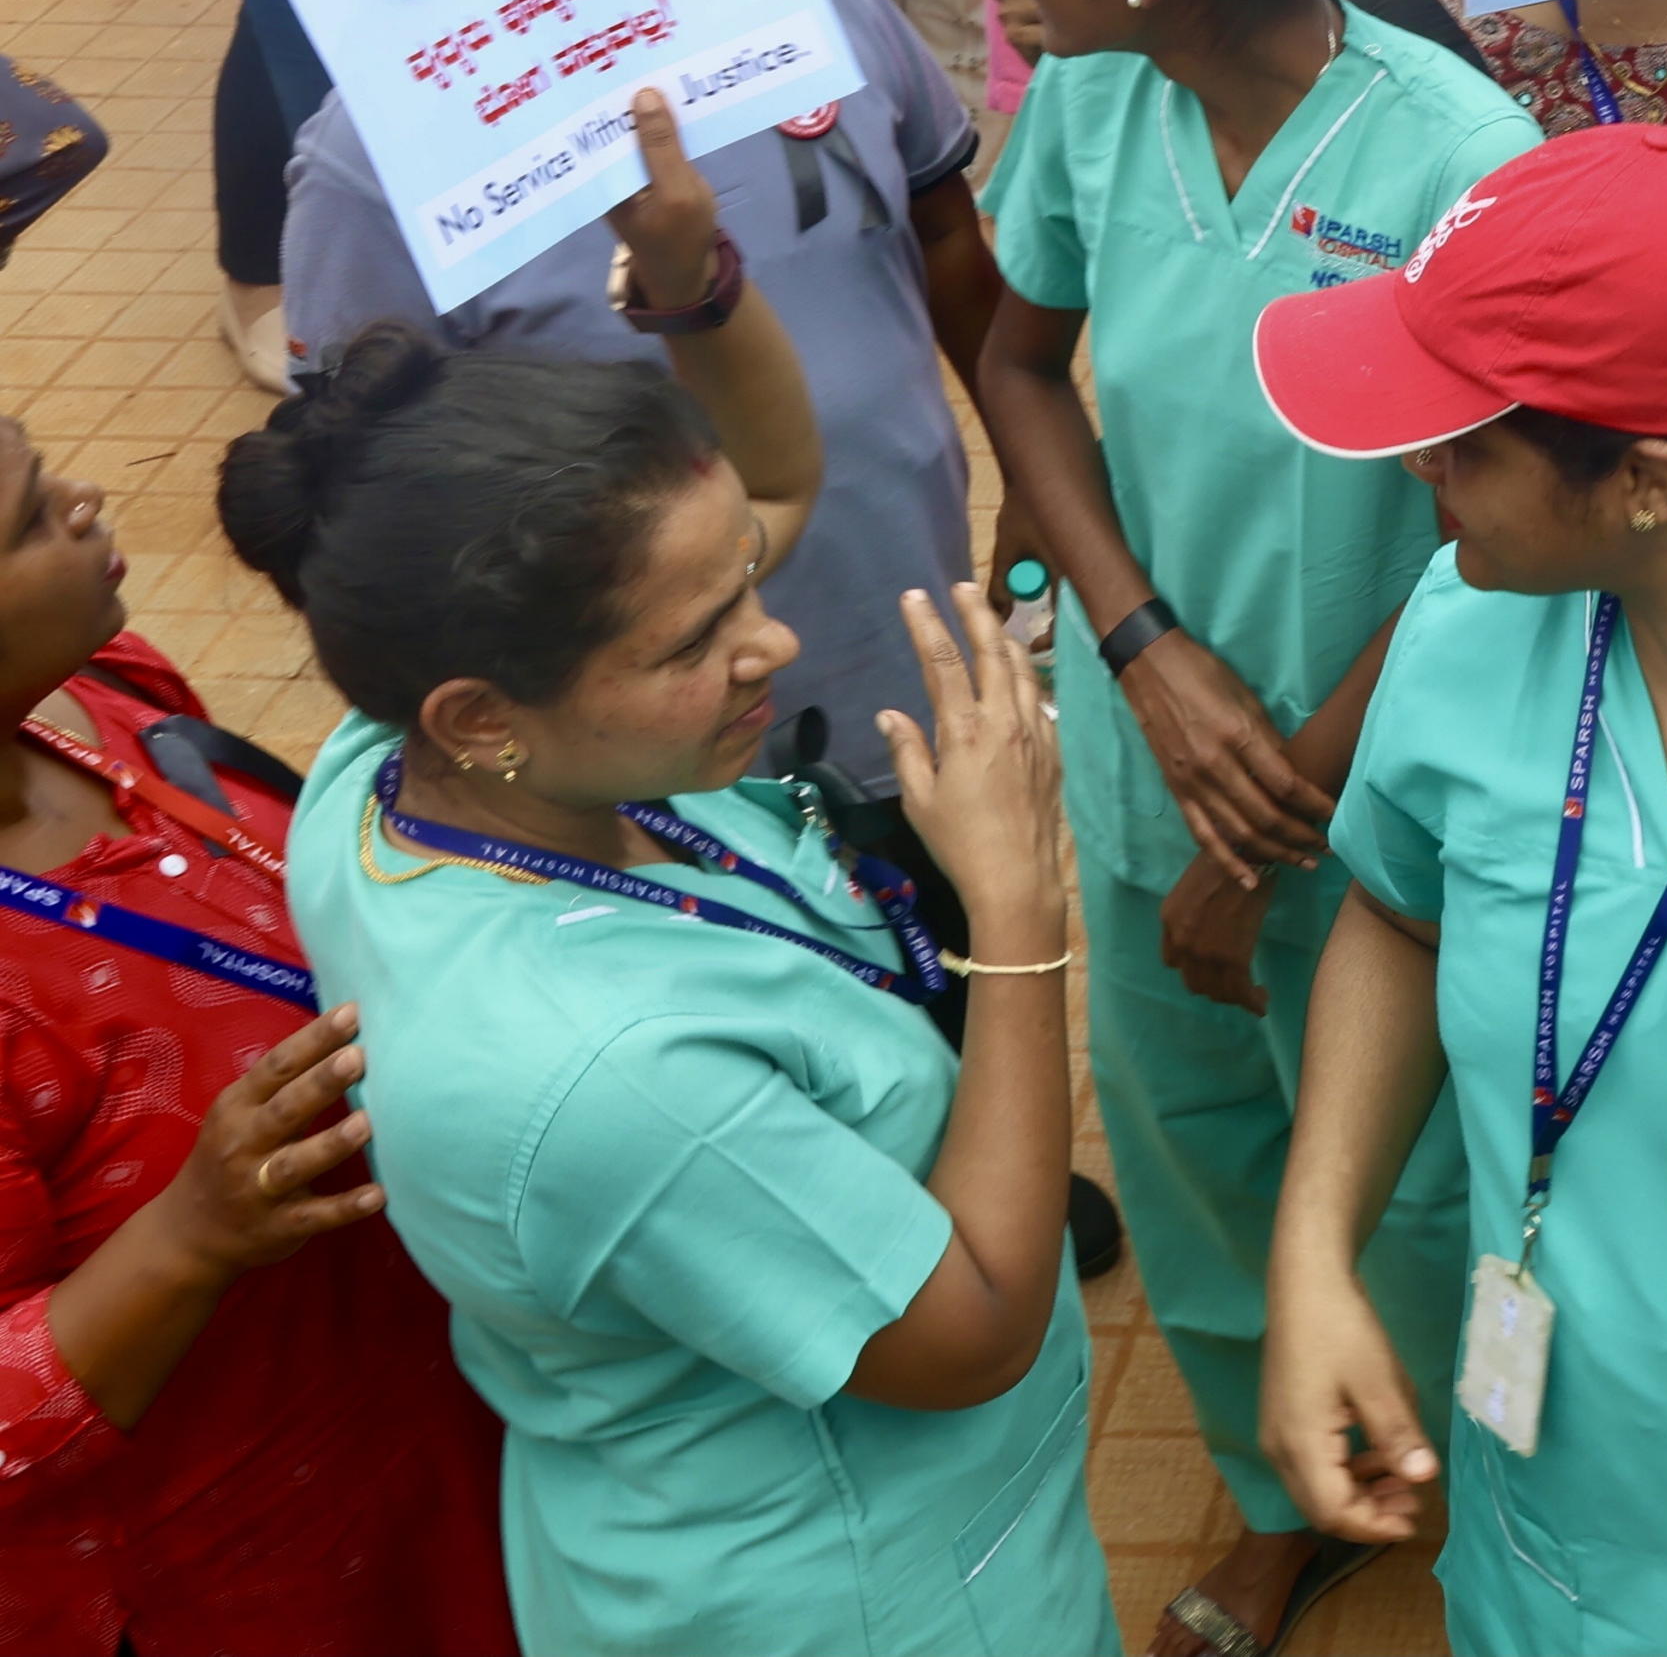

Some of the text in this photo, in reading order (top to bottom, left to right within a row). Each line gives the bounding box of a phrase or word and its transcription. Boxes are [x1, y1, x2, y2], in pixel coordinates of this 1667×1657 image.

[437, 44, 809, 244] No Service Witho Justice.
[1569, 694, 1595, 791] SPARSH
[1536, 880, 1568, 1080] SPARSH HOSPITAL
[1564, 935, 1662, 1108] SPARSH HOSPITAL
